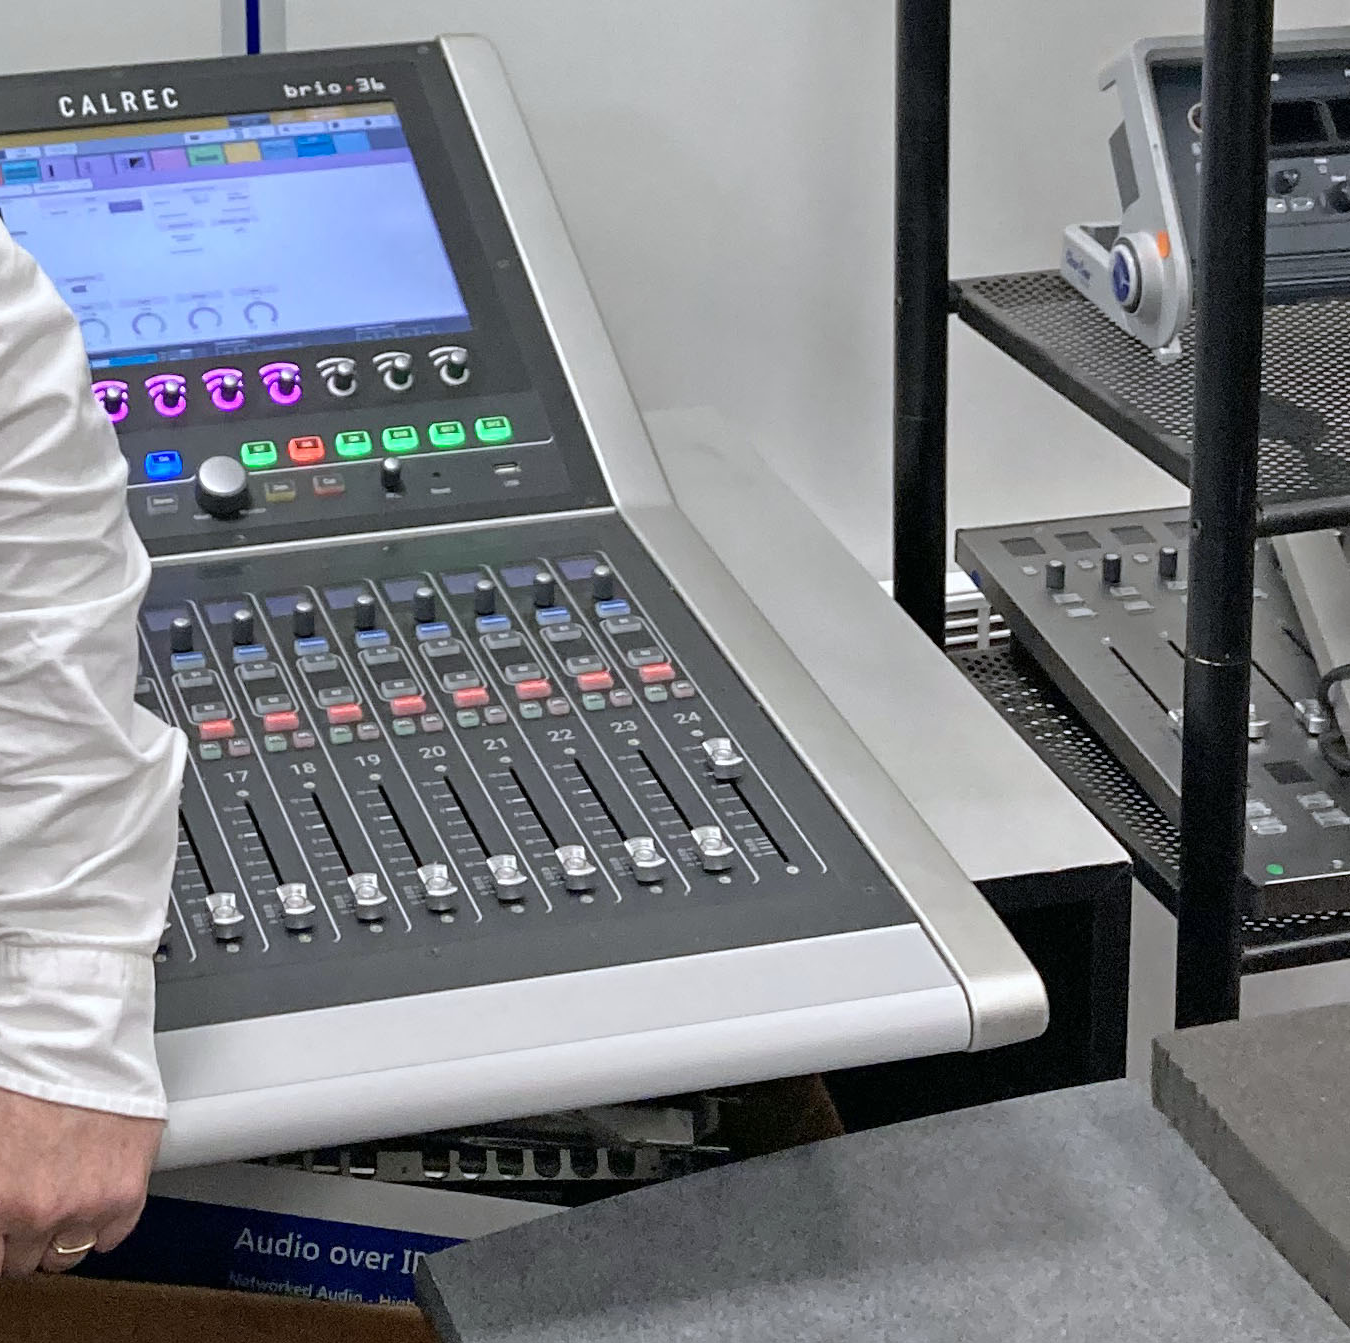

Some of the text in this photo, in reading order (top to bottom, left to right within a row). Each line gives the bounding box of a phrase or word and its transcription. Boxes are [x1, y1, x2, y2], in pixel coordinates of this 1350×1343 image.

[57, 87, 180, 119] CALREC
[673, 711, 702, 725] 24
[610, 720, 638, 734] 23
[547, 728, 576, 742] 22
[483, 737, 509, 751] 21
[419, 745, 446, 759] 20
[354, 753, 381, 767] 19
[290, 761, 317, 775] 18
[223, 770, 249, 783] 17
[233, 1227, 321, 1261] Audio
[329, 1246, 394, 1271] over
